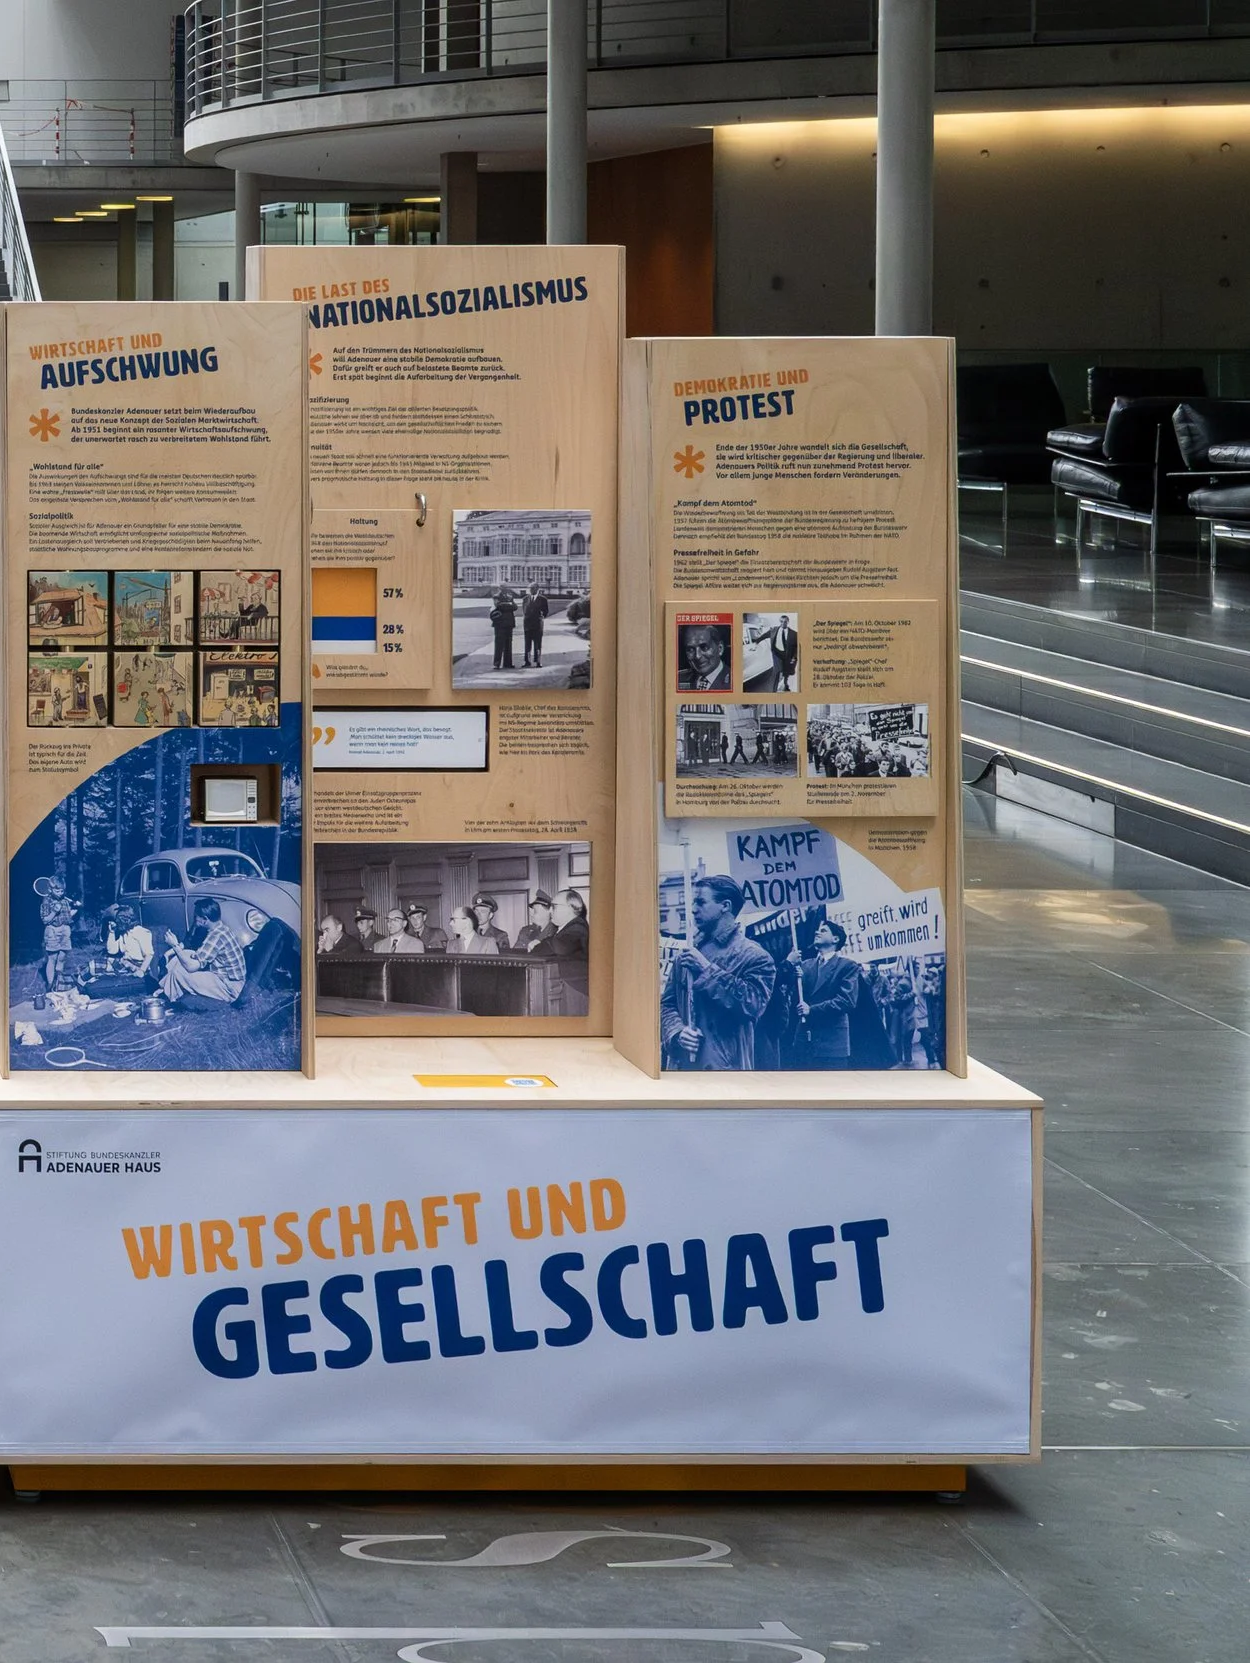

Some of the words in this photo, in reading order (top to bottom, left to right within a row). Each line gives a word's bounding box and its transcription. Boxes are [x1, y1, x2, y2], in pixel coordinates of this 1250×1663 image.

[293, 286, 316, 301] DIE
[322, 282, 358, 298] LAST
[362, 278, 390, 294] DES
[308, 276, 588, 329] NATIONALSOZIALISMUS
[29, 337, 124, 360] WIRTSCHAFT
[130, 332, 162, 350] UND
[40, 346, 218, 390] AUFSCHWUNG
[365, 374, 393, 382] beginnt
[406, 374, 454, 382] Aufarbeitung
[674, 372, 771, 397] DEMOKRATIE
[776, 368, 809, 386] UND
[684, 390, 794, 426] PROTEST
[119, 417, 150, 425] Konzept
[101, 426, 132, 434] beginnt
[836, 453, 876, 462] Regierung
[751, 472, 774, 480] junge
[29, 512, 74, 520] Sozialpolitik
[350, 518, 378, 526] Haltung
[674, 548, 724, 556] Pressefreiheit
[726, 548, 732, 556] in
[734, 548, 759, 556] Gefahr
[692, 614, 719, 622] SPIEGEL
[737, 829, 820, 862] KAMPF
[764, 860, 796, 876] DEM
[742, 873, 841, 908] ATOMTOD
[900, 897, 928, 920] wird
[46, 1151, 88, 1160] STIFTUNG
[91, 1151, 161, 1160] BUNDESKANZLER
[46, 1163, 119, 1173] ADENAUER
[124, 1163, 161, 1173] HAUS
[122, 1191, 482, 1280] WIRTSCHAFT
[508, 1177, 627, 1239] UND
[192, 1218, 889, 1379] GESELLSCHAFT
